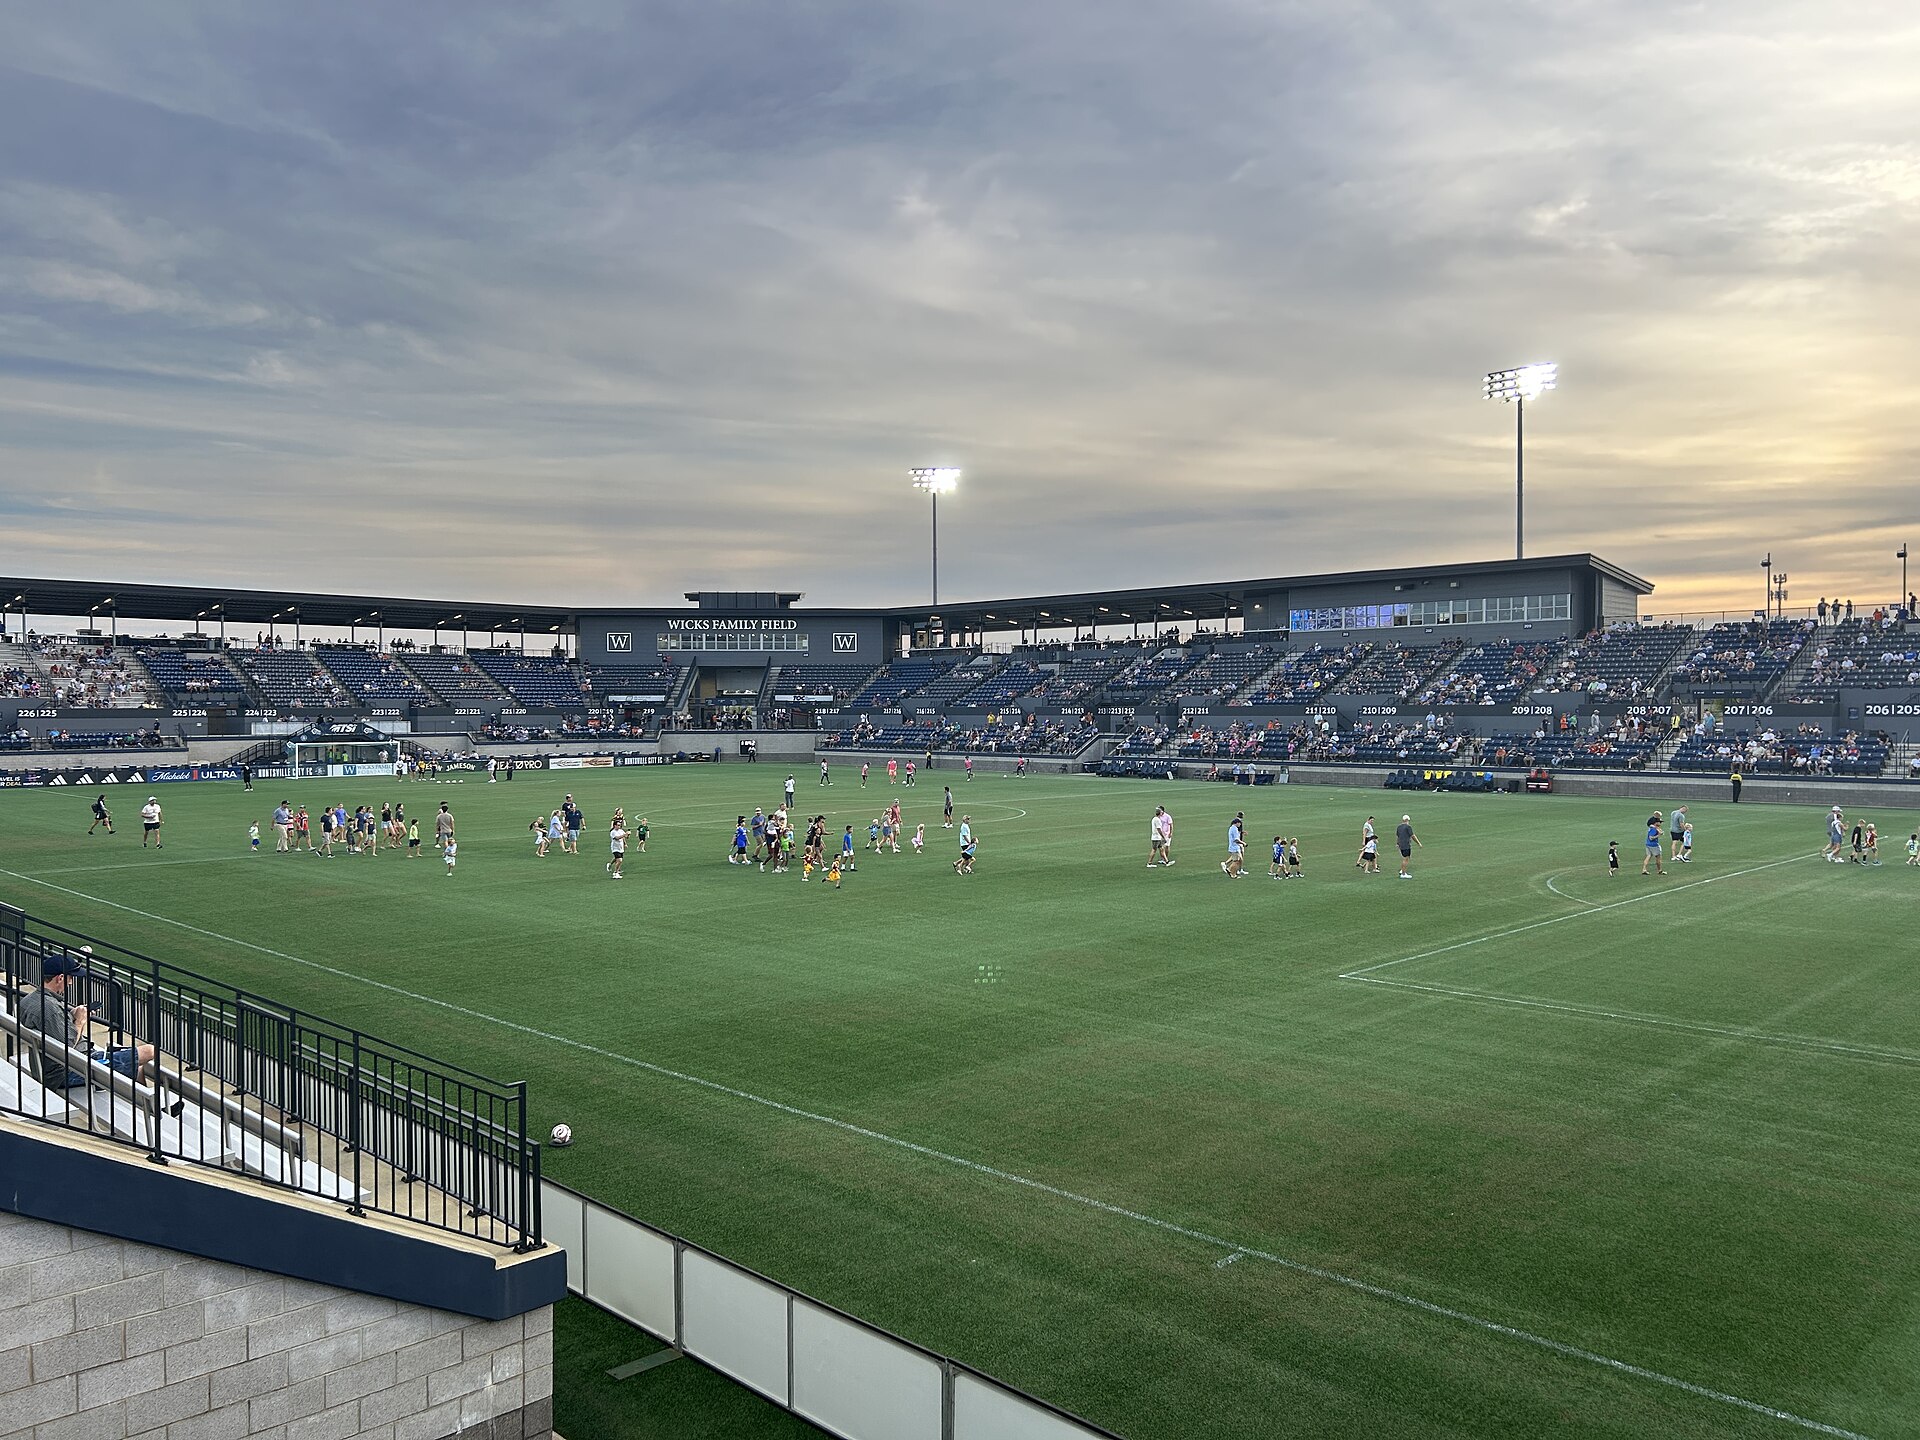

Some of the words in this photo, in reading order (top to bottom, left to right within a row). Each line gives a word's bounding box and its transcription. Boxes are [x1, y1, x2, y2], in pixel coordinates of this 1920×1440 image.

[667, 619, 710, 630] WICKS
[712, 619, 758, 630] FAMILY
[761, 619, 797, 630] FIELD
[609, 635, 629, 649] W
[836, 635, 855, 649] W
[344, 765, 355, 775] W
[446, 762, 476, 772] JAMESON
[523, 760, 543, 770] PRO
[151, 771, 191, 781] Michelob
[201, 770, 237, 779] ULTRA
